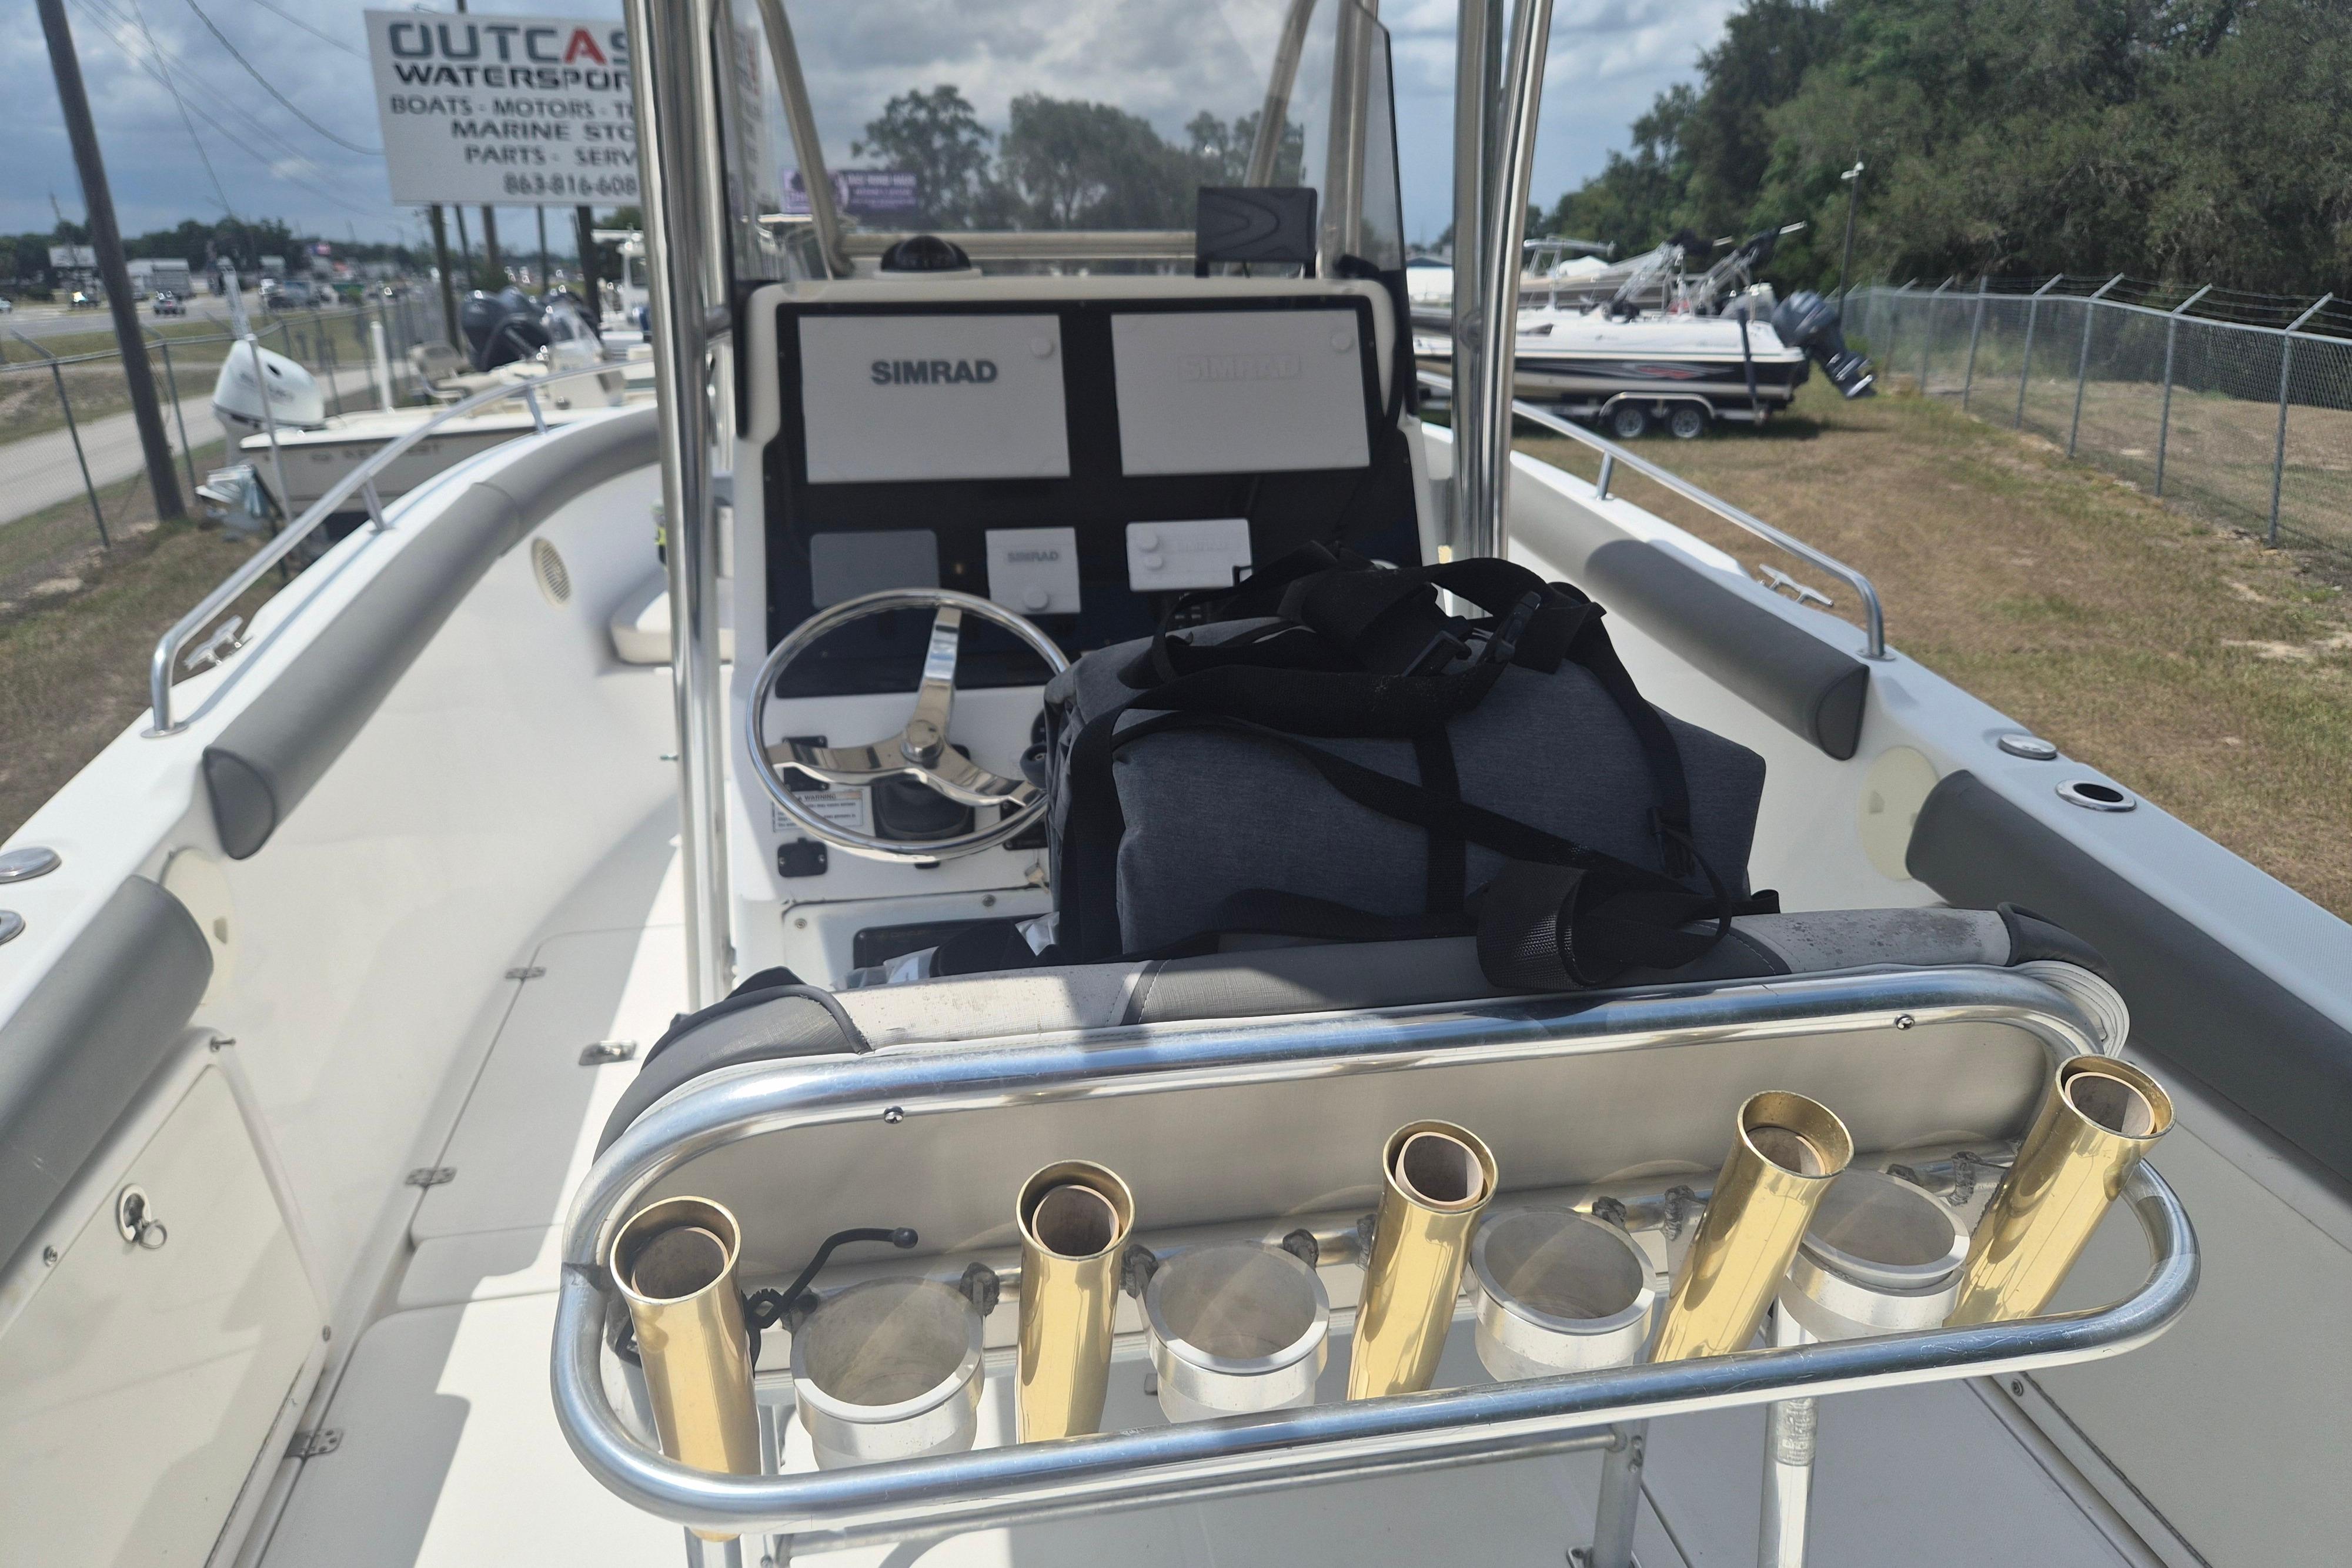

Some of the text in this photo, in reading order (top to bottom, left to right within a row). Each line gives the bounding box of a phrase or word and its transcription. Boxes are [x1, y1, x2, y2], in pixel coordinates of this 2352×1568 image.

[390, 96, 472, 116] BOATS
[495, 98, 594, 118] MOTORS
[452, 119, 570, 140] MARINE
[465, 146, 546, 165] PARTS
[871, 359, 998, 385] SIMRAD
